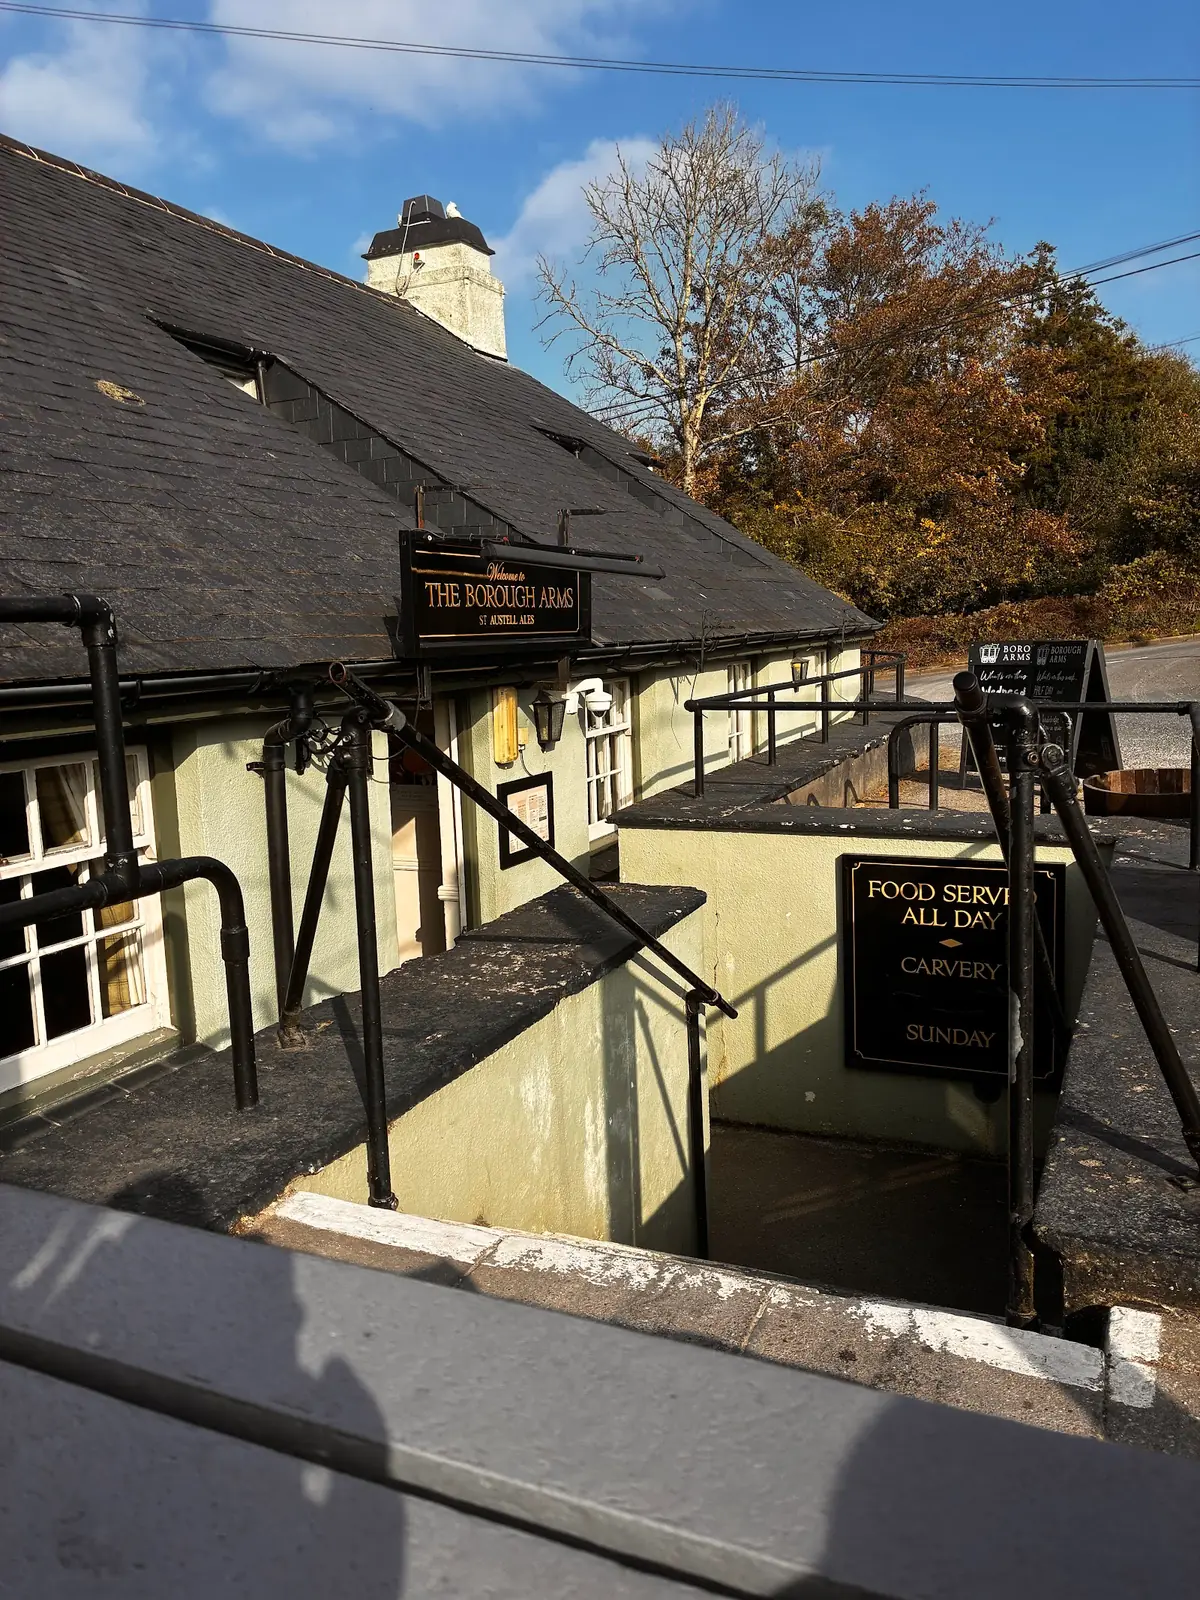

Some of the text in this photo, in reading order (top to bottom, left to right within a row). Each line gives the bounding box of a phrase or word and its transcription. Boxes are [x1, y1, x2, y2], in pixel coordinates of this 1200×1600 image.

[487, 562, 526, 581] Welcome to
[425, 582, 574, 608] THE BOROUGH ARMS
[490, 614, 518, 625] AUSTELL
[519, 614, 535, 625] ALES
[1002, 653, 1031, 661] ARMS
[1049, 654, 1067, 663] ARMS
[1051, 645, 1082, 655] BOROUGH
[868, 880, 1037, 906] FOOD SERV
[901, 906, 1003, 931] ALL DAY
[901, 956, 1003, 980] CARVERY
[906, 1024, 996, 1048] SUNDAY
